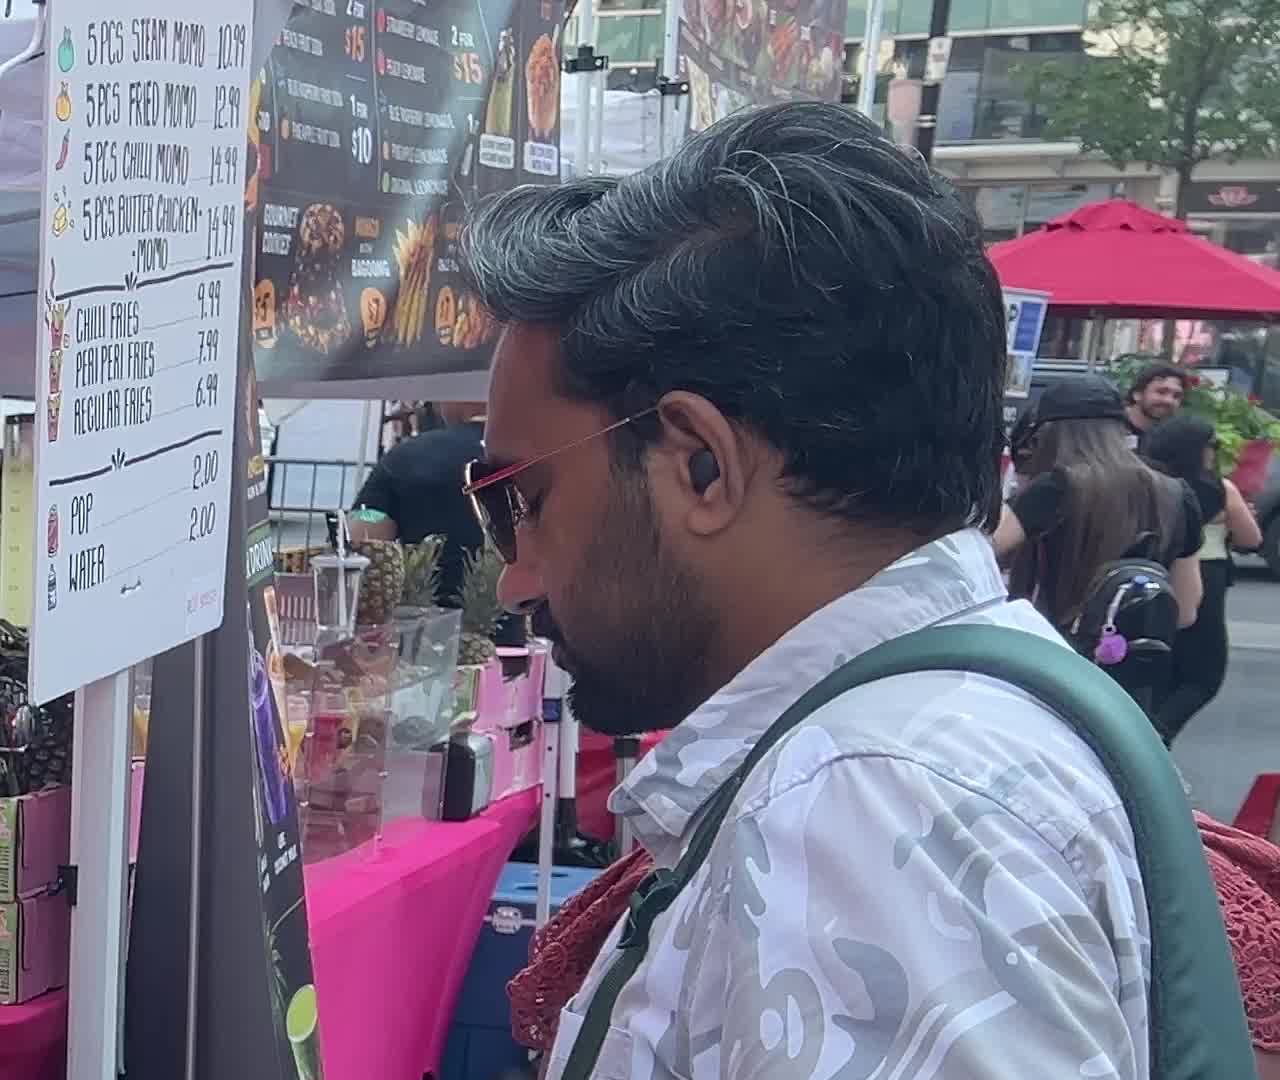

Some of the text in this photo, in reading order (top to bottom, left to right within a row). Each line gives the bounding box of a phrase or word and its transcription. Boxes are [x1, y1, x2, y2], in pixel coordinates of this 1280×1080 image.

[87, 19, 97, 66] 5
[100, 20, 124, 65] PCS
[131, 18, 167, 63] STEAM
[172, 21, 205, 67] MOMO
[217, 24, 246, 69] 10.99
[345, 25, 365, 62] $15
[86, 82, 96, 128] 5
[98, 82, 120, 128] PCS
[128, 80, 160, 127] FRIED
[162, 83, 197, 128] MOMO
[214, 86, 240, 130] 12.99
[84, 140, 238, 186] 5 PCS CHILLI MOMO 14.99
[351, 125, 372, 164] $10
[83, 198, 92, 241] 5
[93, 196, 115, 240] PCS
[118, 193, 154, 235] BUTTER
[205, 205, 235, 260] 14.99
[76, 280, 221, 344] CHILLI FRIES 9.99
[75, 329, 219, 389] PERI PERI FRIES 7.99
[74, 374, 218, 436] REGULAR FRIES 6.99
[192, 450, 218, 490] 2.00
[71, 493, 93, 536] POP
[190, 502, 215, 542] 2.00
[69, 544, 105, 592] WATER
